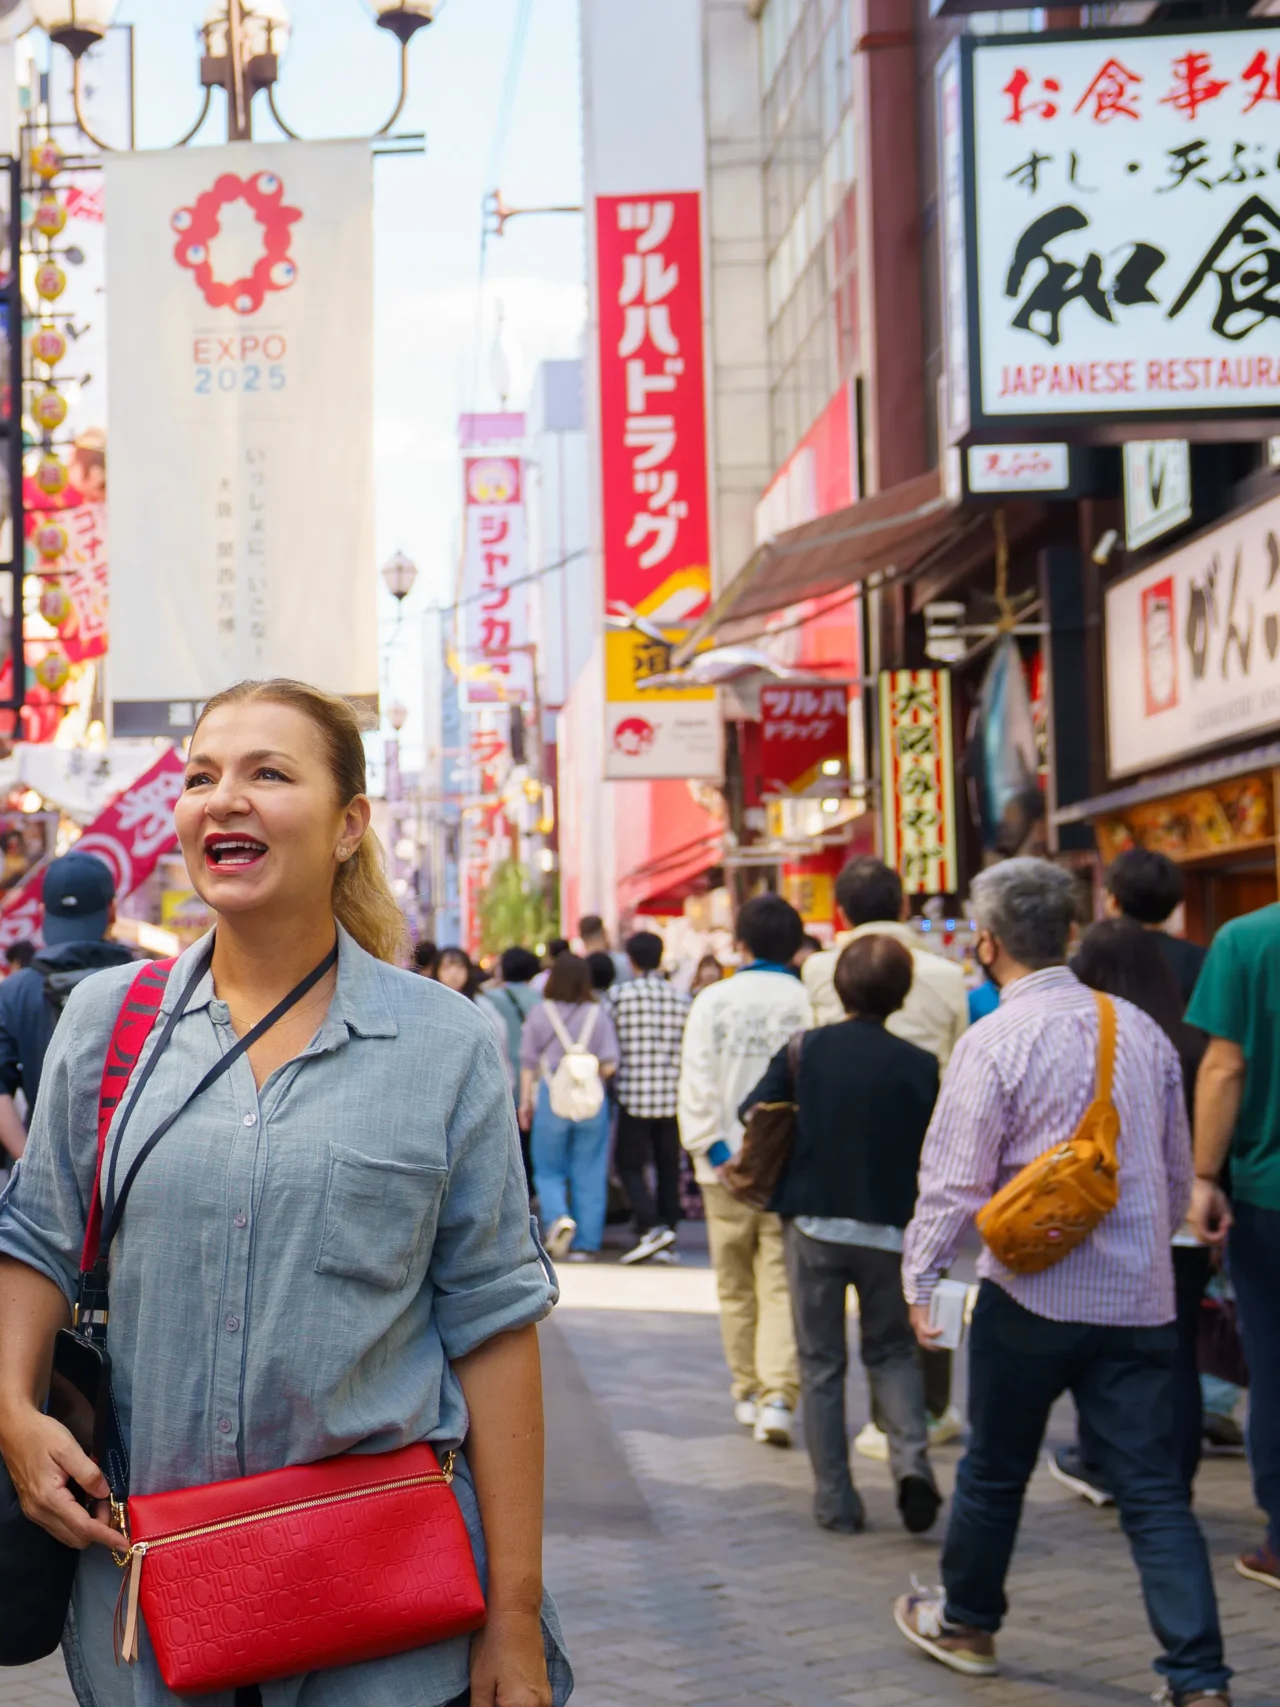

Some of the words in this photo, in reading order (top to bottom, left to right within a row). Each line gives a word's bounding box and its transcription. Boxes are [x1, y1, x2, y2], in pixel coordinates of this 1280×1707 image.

[1004, 140, 1280, 195] すし・天ぷ
[1004, 194, 1280, 346] 和食
[192, 333, 287, 365] EXPO
[194, 364, 287, 395] 2025
[617, 200, 689, 570] ツルハドラッグ
[999, 360, 1137, 397] JAPANESE
[1147, 354, 1280, 391] RESTAUR
[763, 689, 847, 717] ツルハ
[763, 718, 833, 741] ドラッグ
